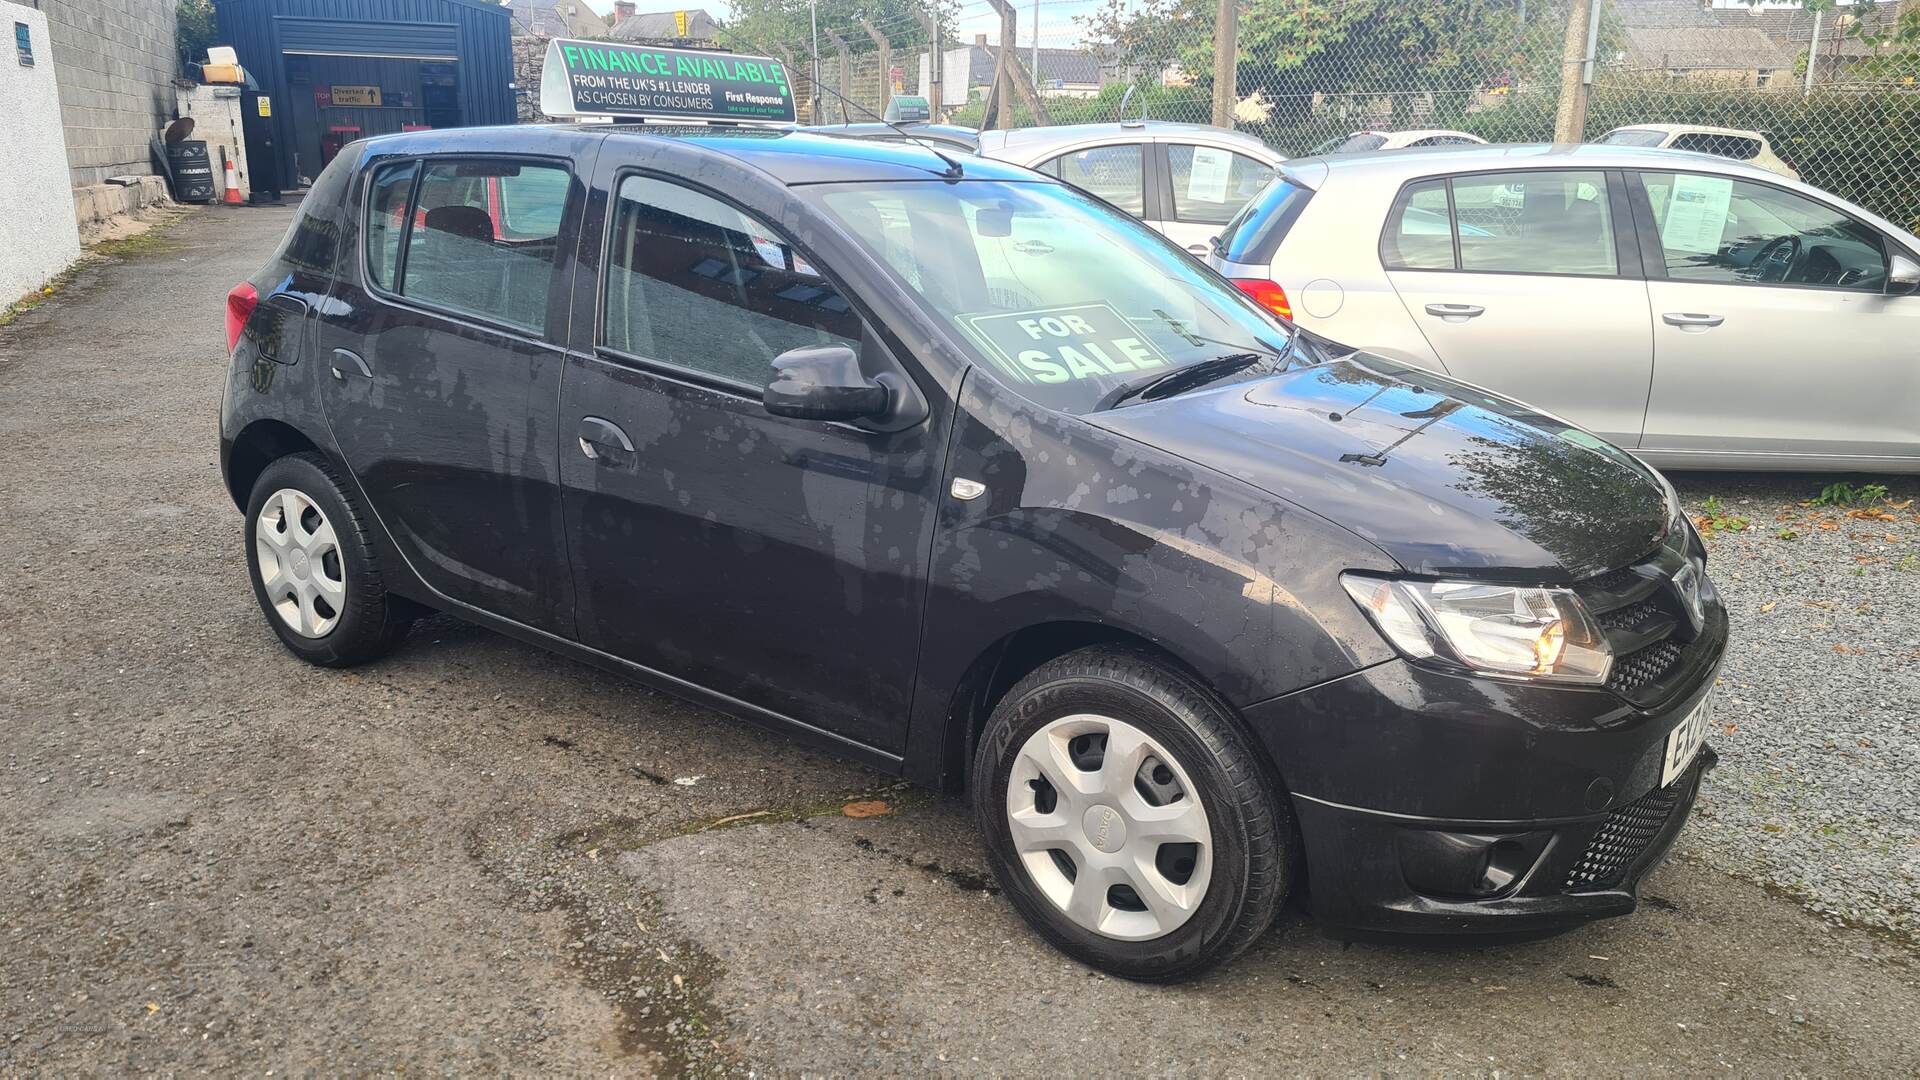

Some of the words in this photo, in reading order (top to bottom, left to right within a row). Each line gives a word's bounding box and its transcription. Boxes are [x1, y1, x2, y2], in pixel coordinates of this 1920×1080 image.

[563, 46, 672, 76] FINANCE
[675, 55, 786, 84] AVAILABLE
[573, 75, 606, 88] FROM
[607, 77, 631, 90] THE
[631, 79, 657, 91] UK'S
[658, 81, 671, 93] #1
[672, 82, 712, 95] LENDER
[577, 91, 591, 103] AS
[593, 92, 637, 105] CHOSEN
[639, 95, 652, 106] BY
[653, 96, 714, 110] CONSUMERS
[725, 91, 745, 103] First
[745, 93, 783, 105] Response
[1016, 314, 1097, 341] FOR
[1018, 337, 1165, 384] SALE
